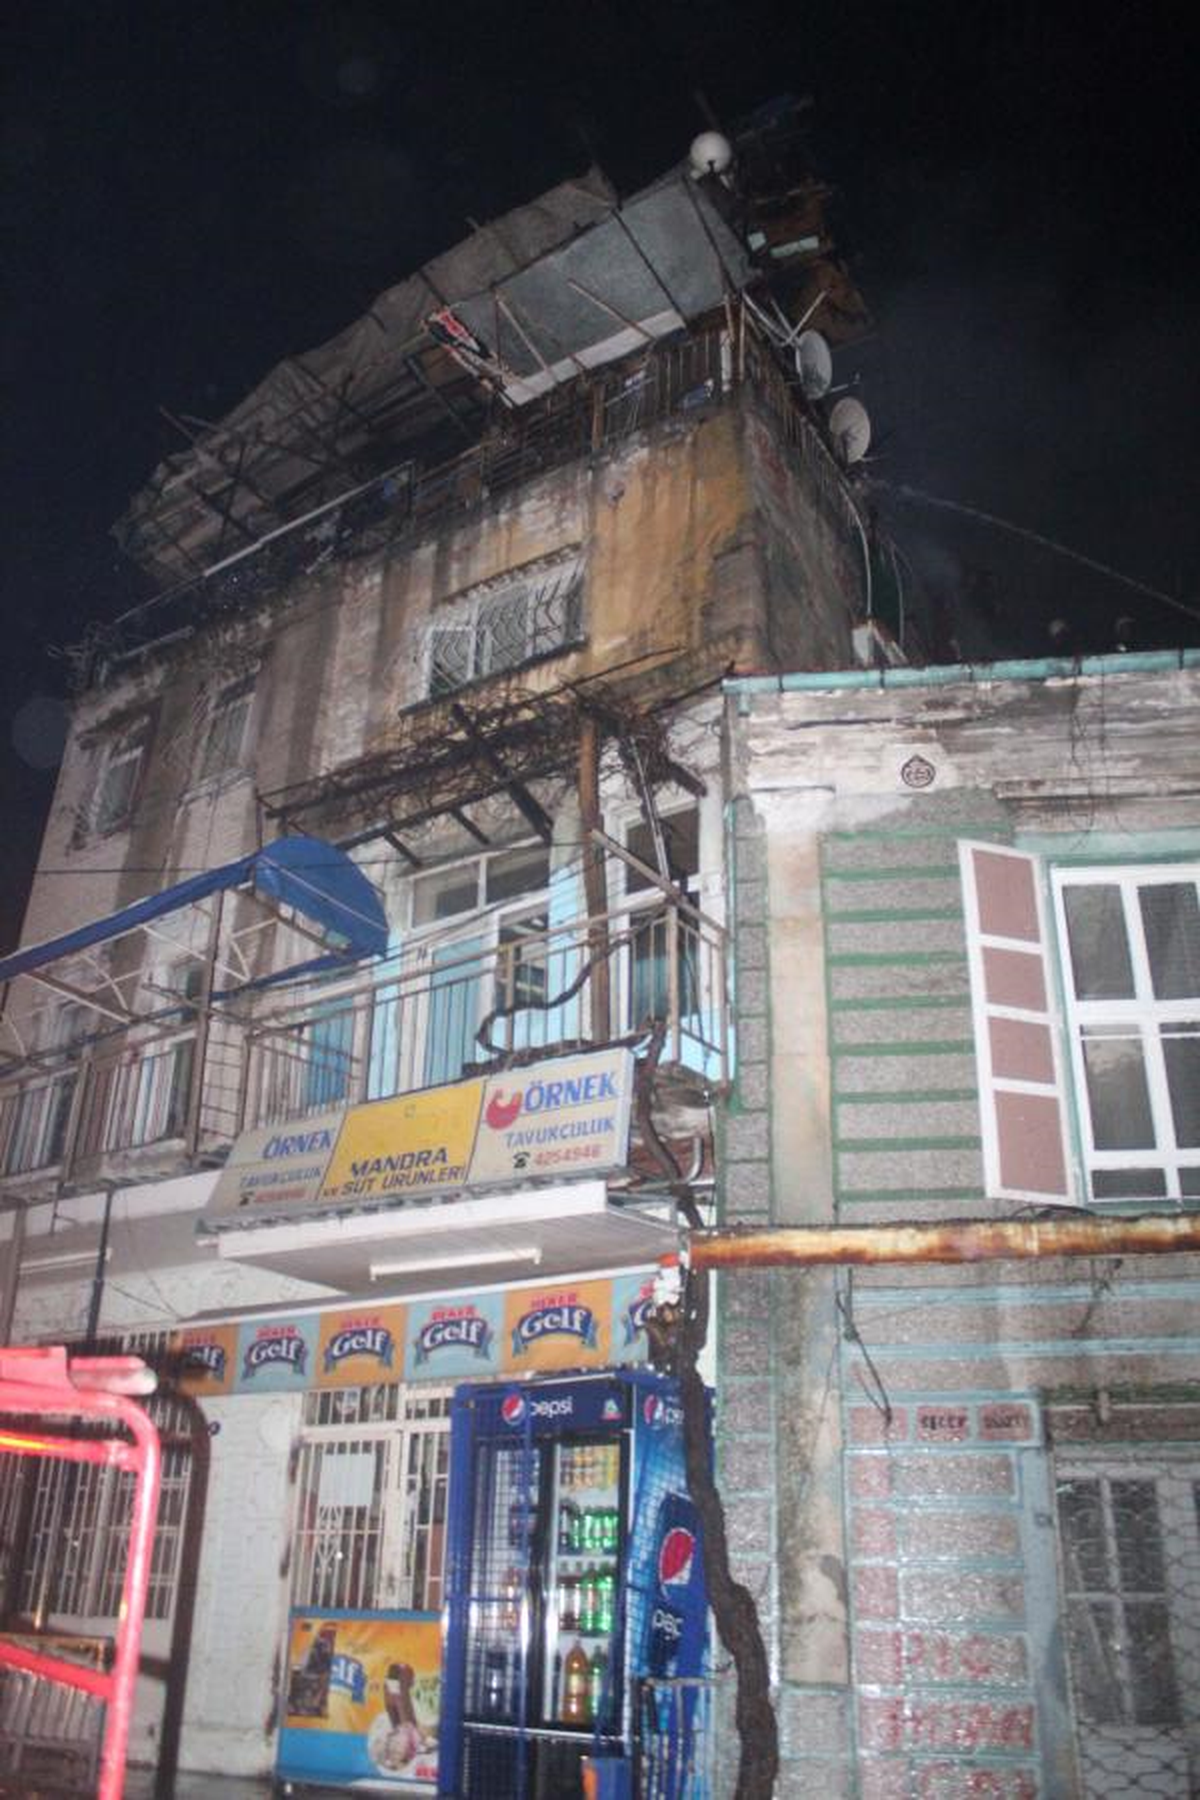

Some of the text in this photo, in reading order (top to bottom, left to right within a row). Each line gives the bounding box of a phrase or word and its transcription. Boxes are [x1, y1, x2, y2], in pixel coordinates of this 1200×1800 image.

[524, 1071, 618, 1113] ÖRNEK
[350, 1147, 448, 1179] MANDRA
[423, 1318, 485, 1349] Golf
[520, 1308, 588, 1339] Golf
[250, 1338, 302, 1364] Golf
[332, 1328, 389, 1357] Golf
